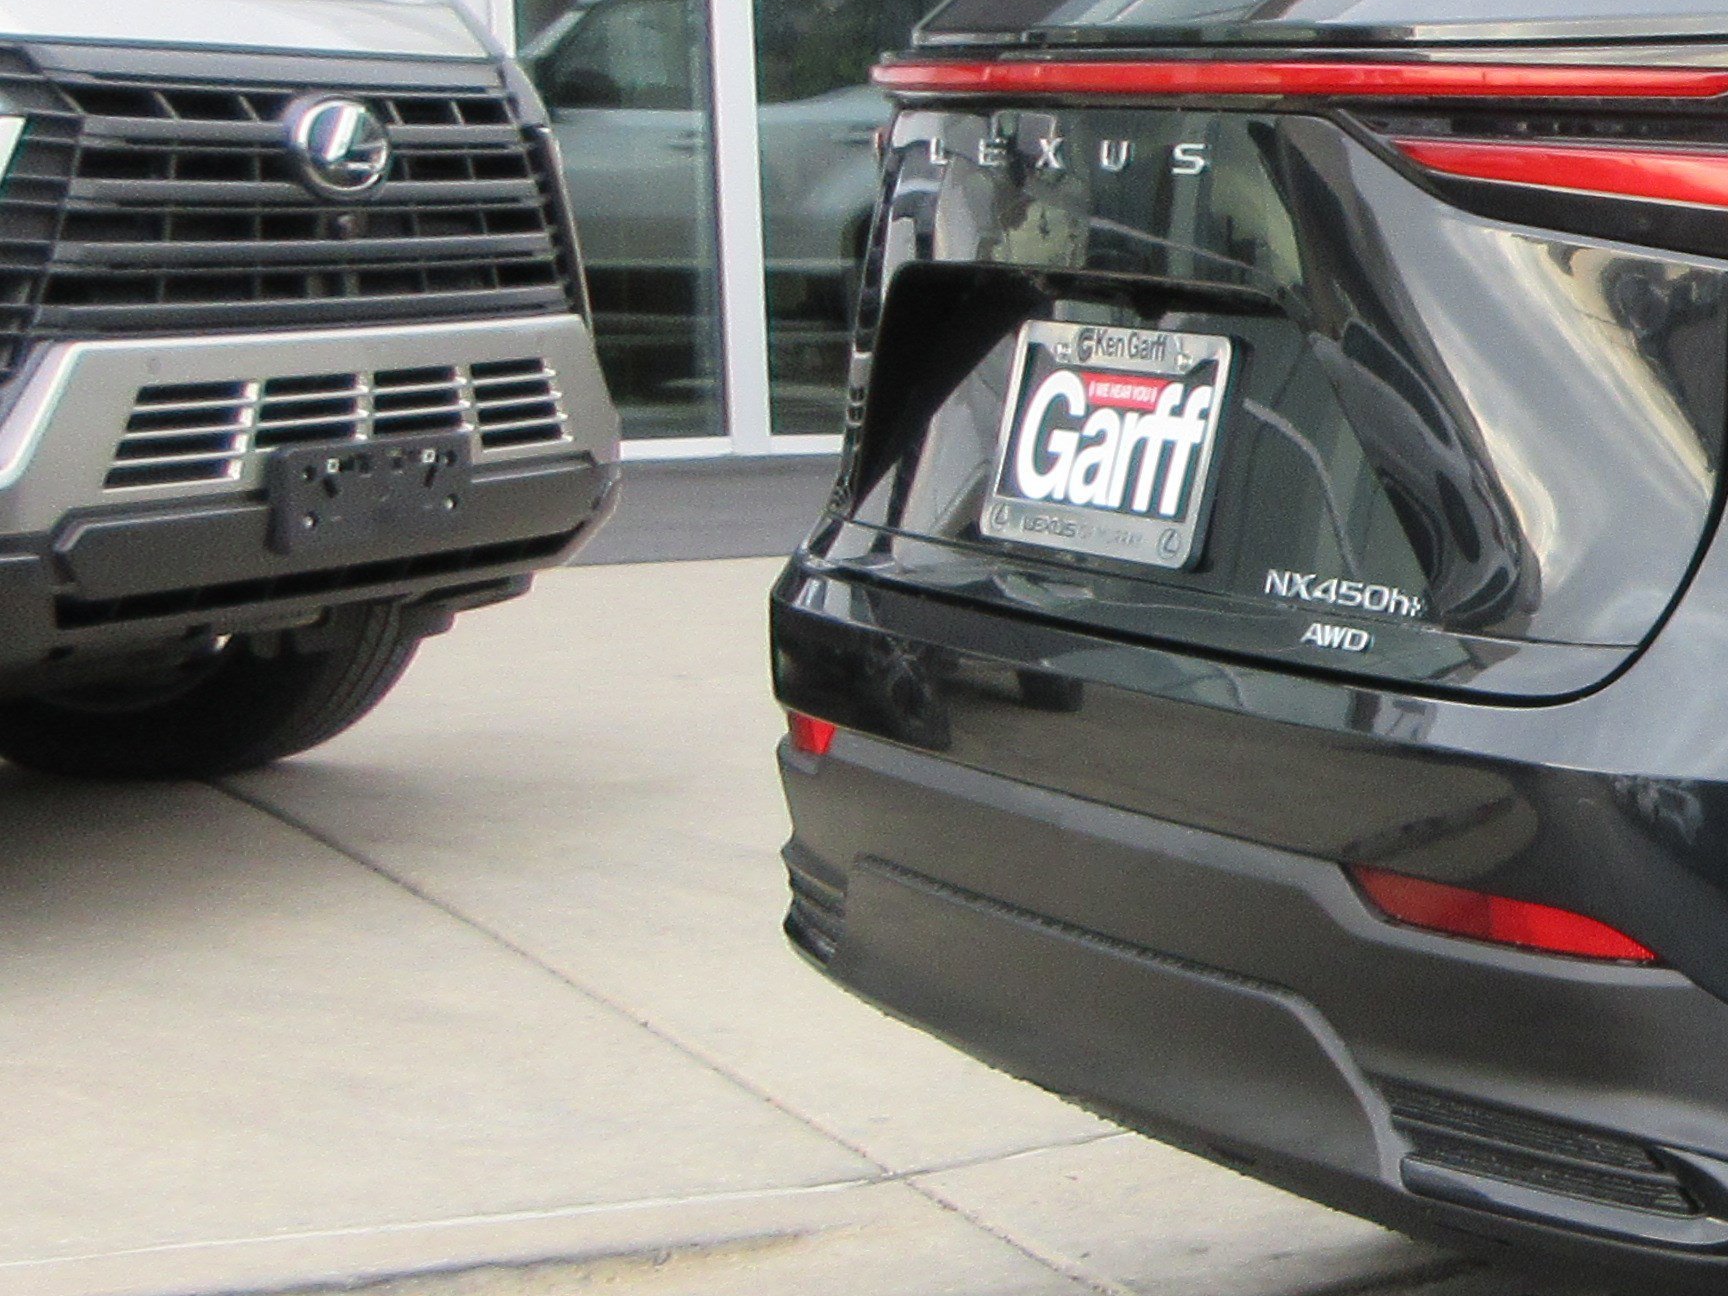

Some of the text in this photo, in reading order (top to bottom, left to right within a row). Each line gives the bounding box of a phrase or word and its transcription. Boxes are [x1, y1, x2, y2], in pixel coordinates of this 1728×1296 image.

[929, 136, 1209, 176] LEXUS
[1095, 328, 1167, 362] Ken Garff
[1016, 369, 1214, 517] Garff
[1264, 568, 1422, 617] NX450h+
[1300, 622, 1370, 652] AWD
